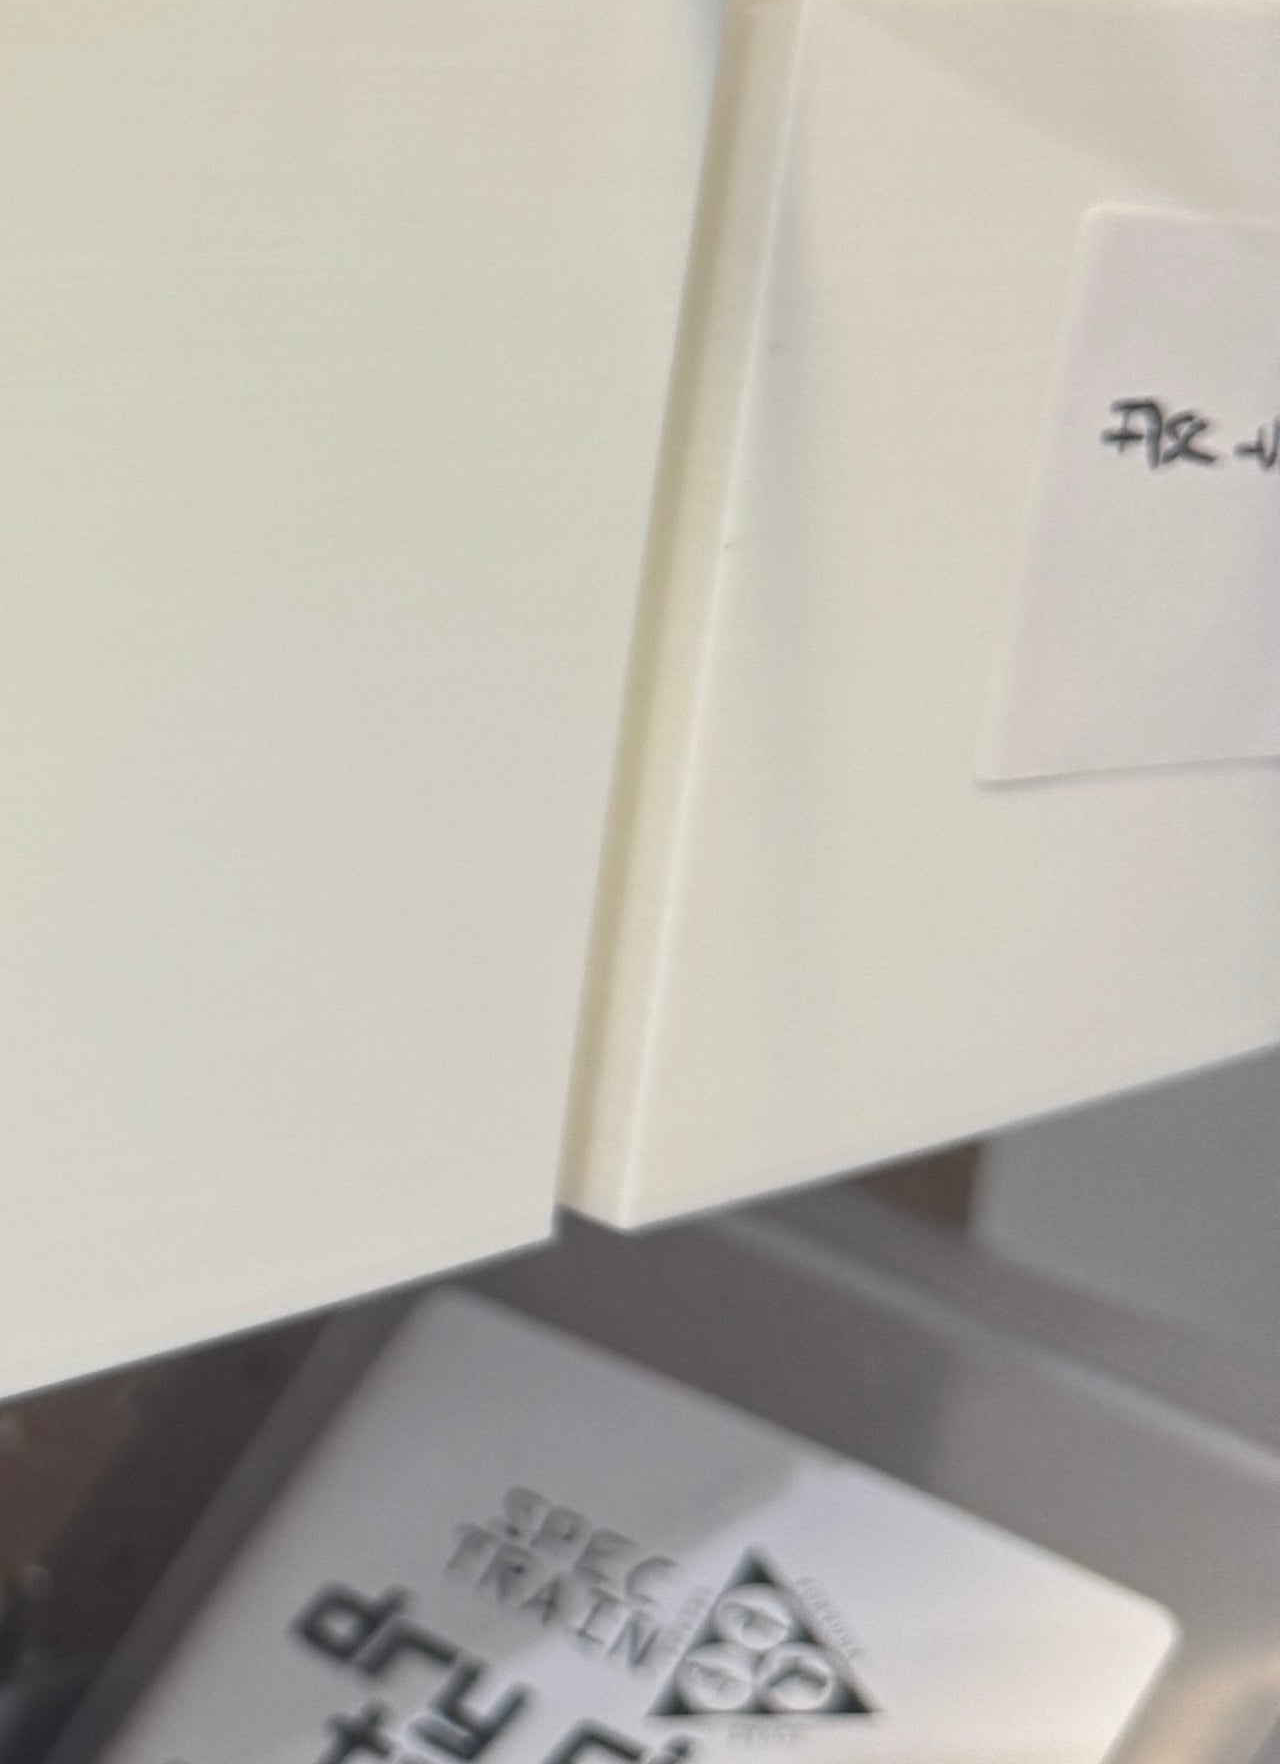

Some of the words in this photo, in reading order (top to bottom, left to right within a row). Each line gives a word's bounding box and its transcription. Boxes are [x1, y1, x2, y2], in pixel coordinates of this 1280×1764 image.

[443, 1520, 662, 1670] TRAIN
[486, 1483, 682, 1608] SPEC
[289, 1578, 532, 1762] dry
